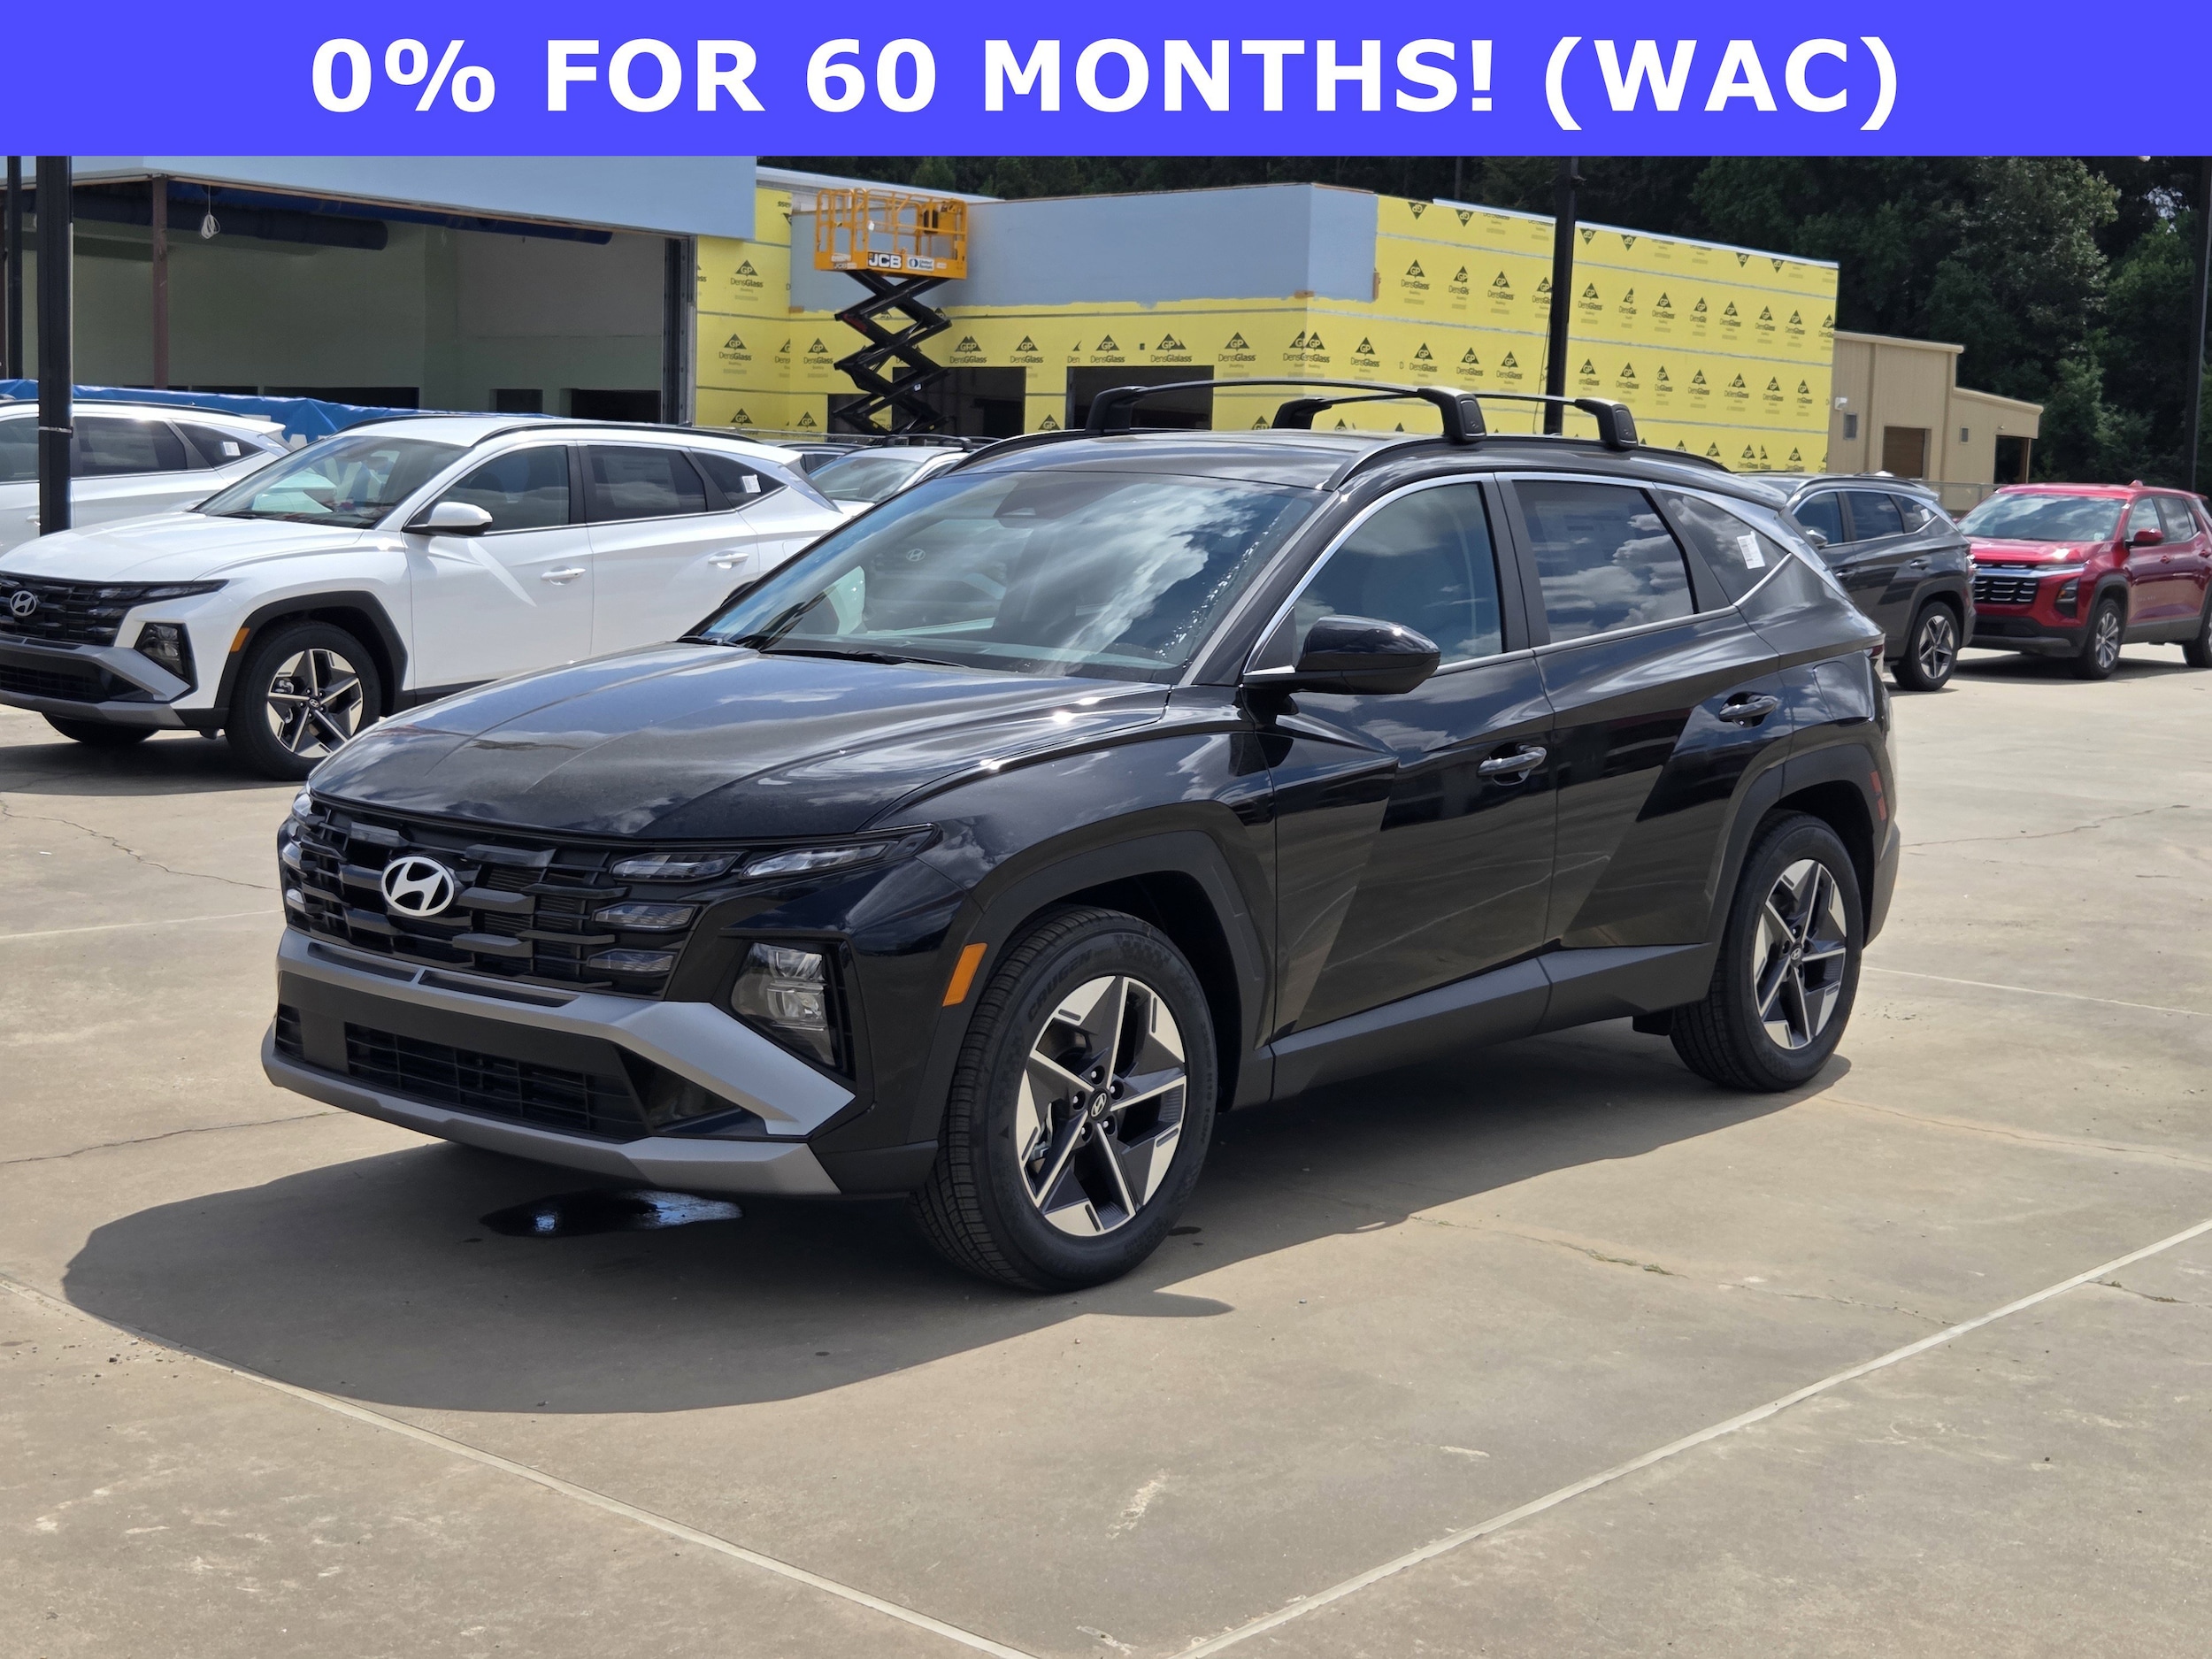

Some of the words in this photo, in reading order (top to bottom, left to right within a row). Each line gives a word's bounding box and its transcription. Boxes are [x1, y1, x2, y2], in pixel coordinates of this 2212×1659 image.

[868, 253, 902, 269] JCB
[731, 278, 763, 288] DensGlass
[1402, 279, 1430, 290] DensGlass
[1487, 290, 1515, 301] DensGlass
[718, 352, 752, 361] DensGlass
[1350, 357, 1380, 368] DensGlass
[1409, 363, 1438, 373] DensGlass
[1456, 366, 1484, 377] DensGlass
